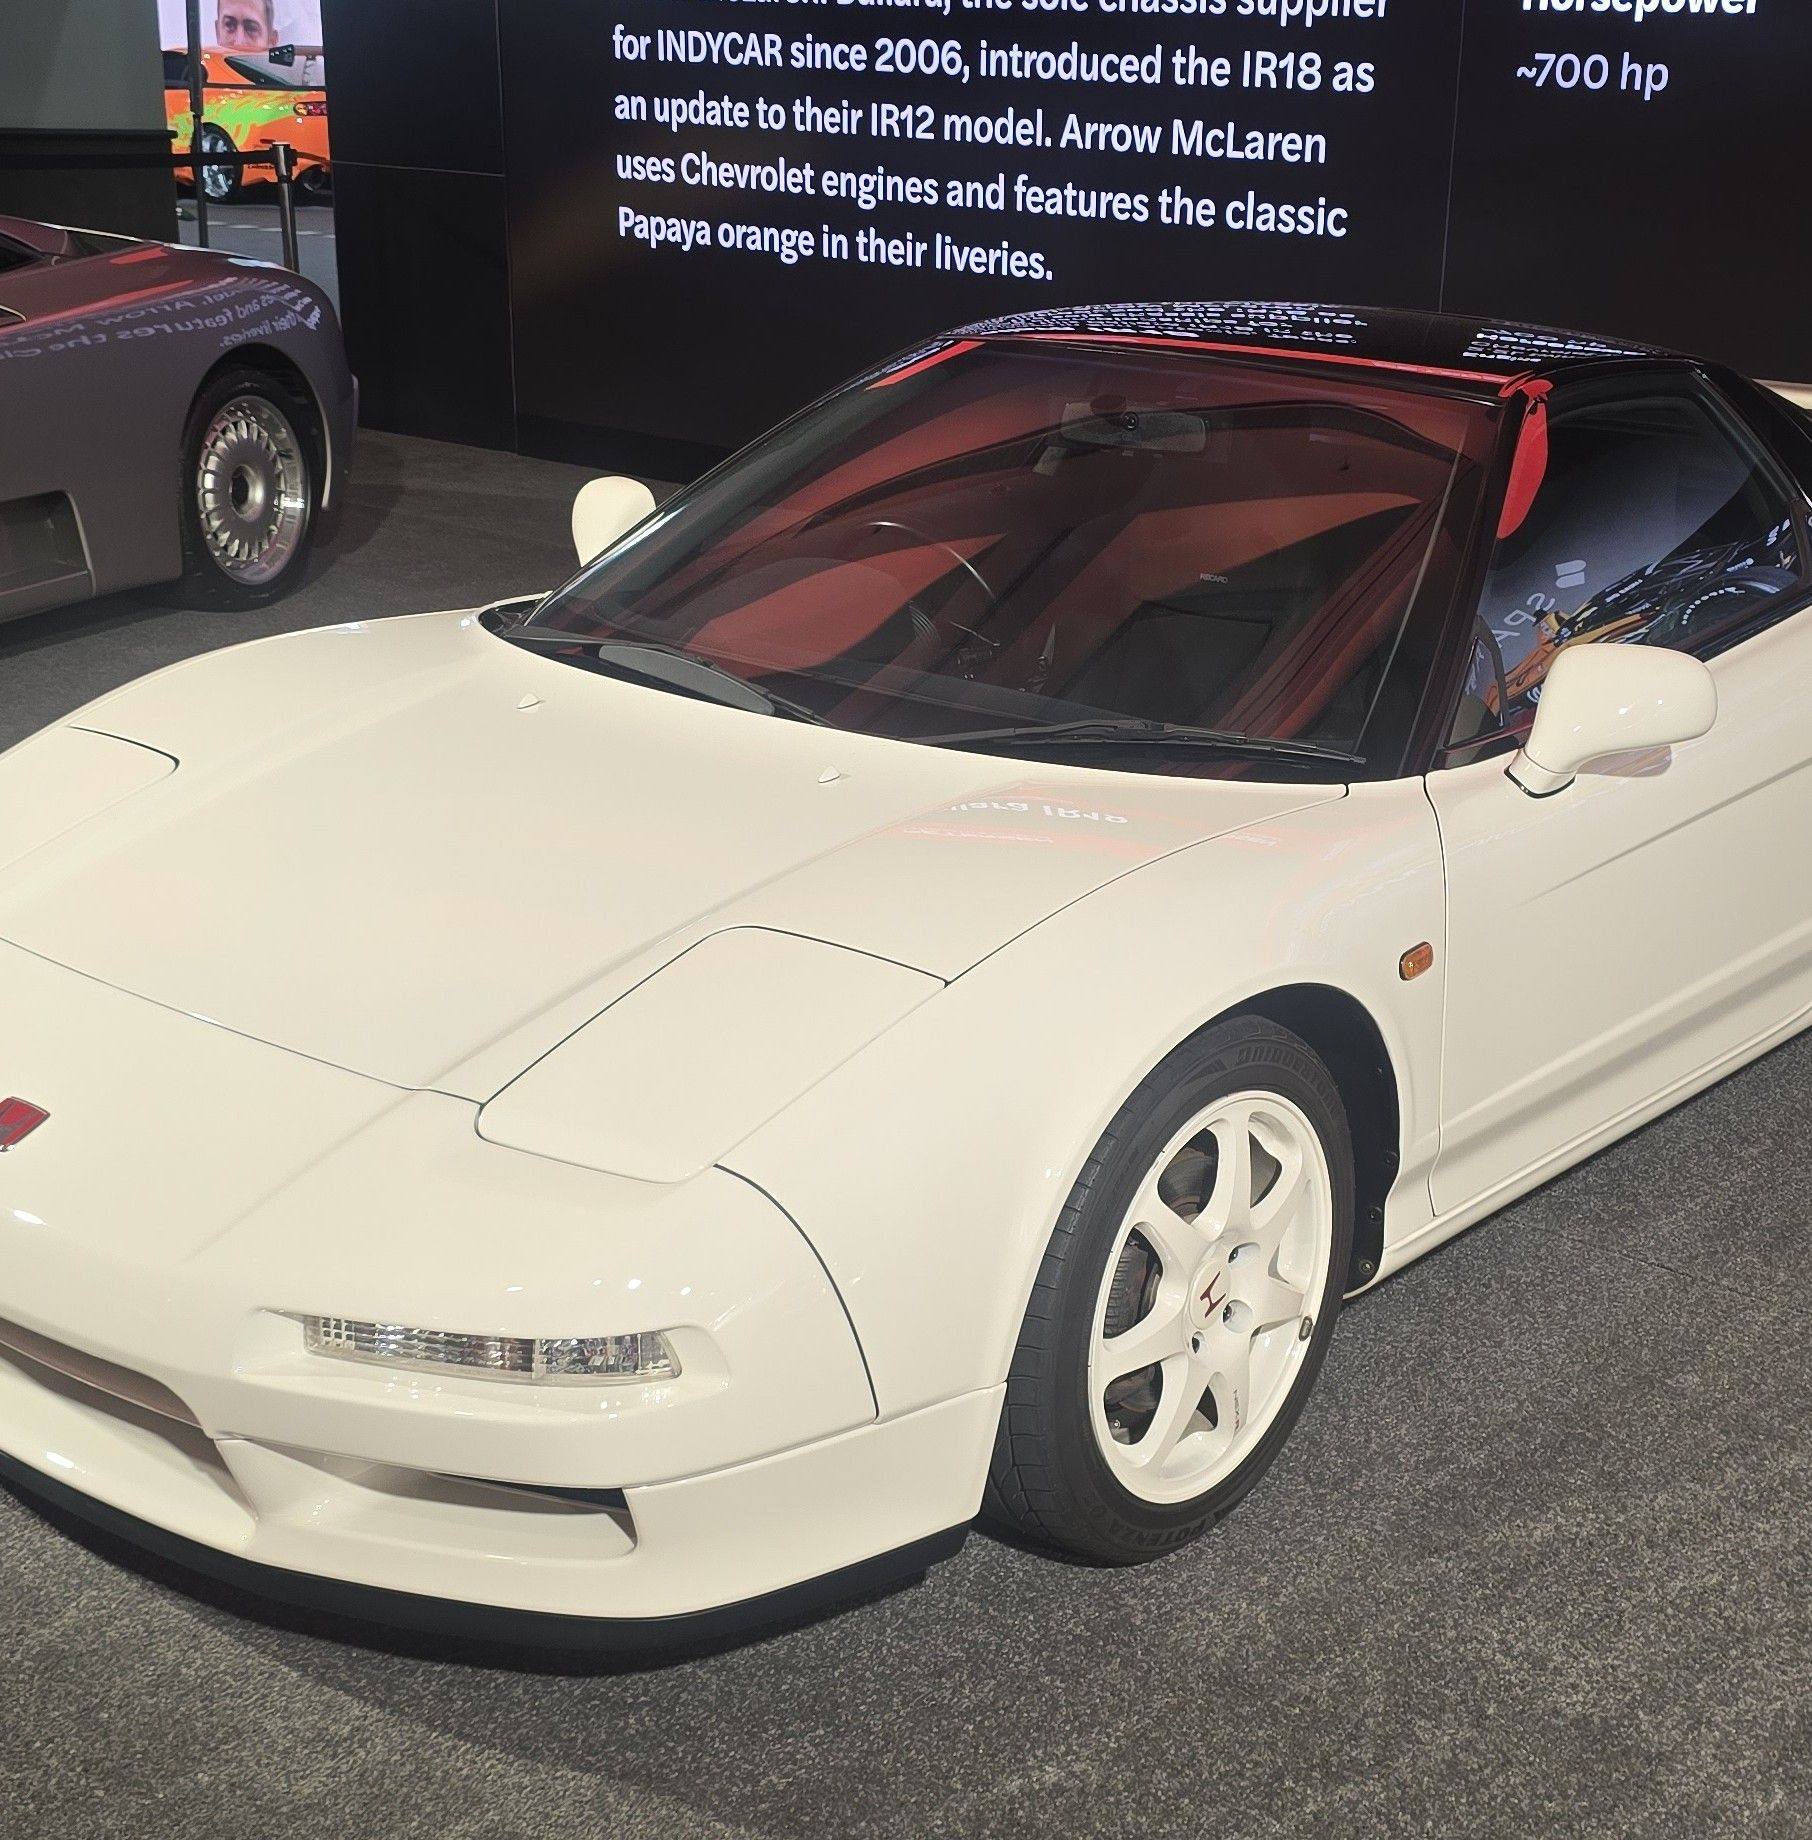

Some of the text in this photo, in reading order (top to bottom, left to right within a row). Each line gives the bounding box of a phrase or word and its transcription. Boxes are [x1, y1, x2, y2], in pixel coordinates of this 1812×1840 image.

[612, 24, 1374, 92] for INDYCAR since 2006, introduced the IR18 as
[1517, 52, 1668, 101] ~700 hp
[615, 90, 1325, 163] an update to their IR12 model. Arrow McLaren
[617, 151, 1348, 237] uses Chevrolet engines and features the classic
[619, 206, 1052, 280] Papaya orange in their liveries.
